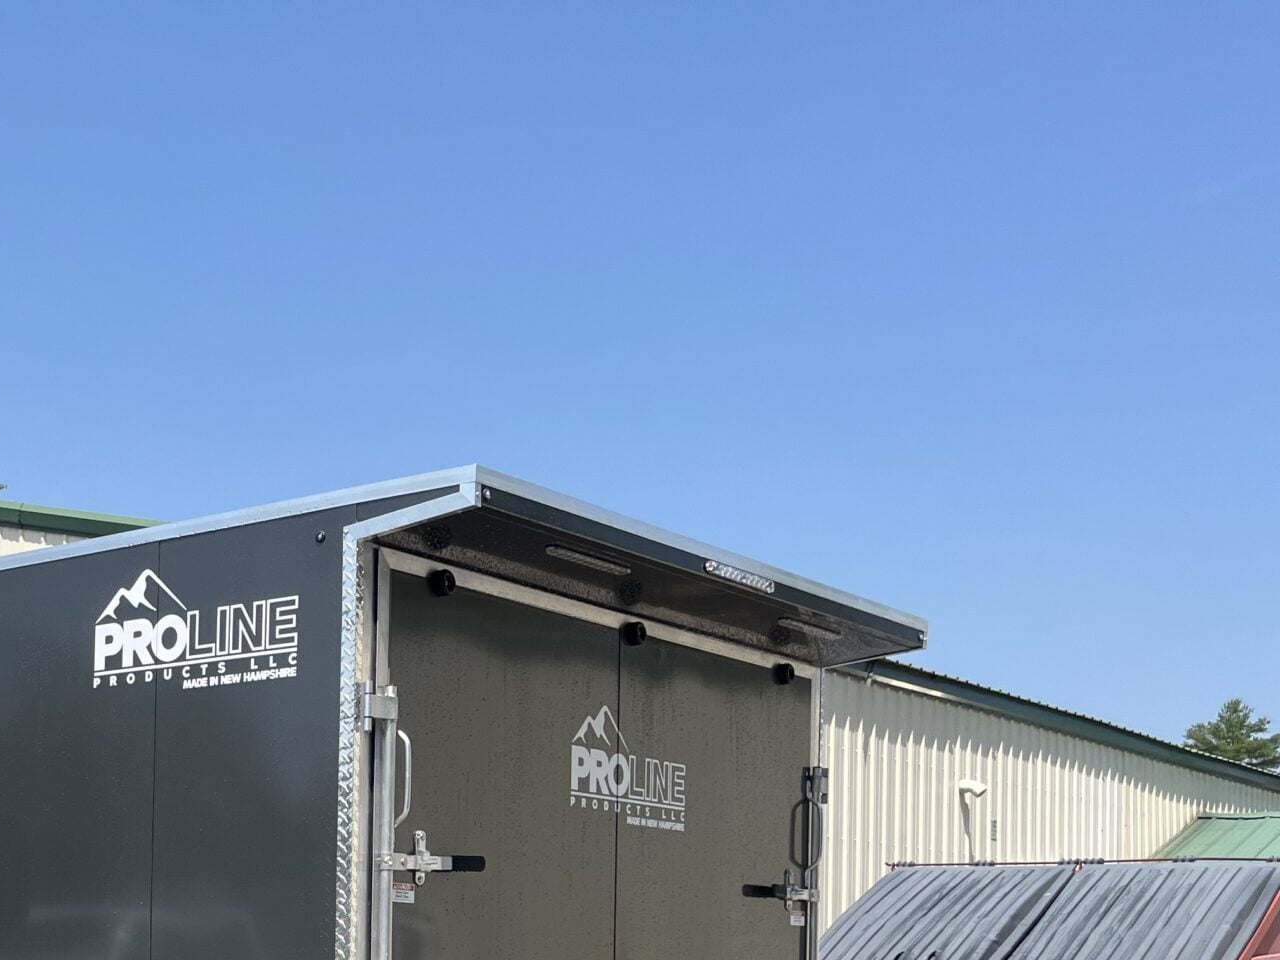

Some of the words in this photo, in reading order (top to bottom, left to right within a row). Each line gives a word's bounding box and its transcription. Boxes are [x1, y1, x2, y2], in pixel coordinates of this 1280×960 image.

[94, 595, 299, 672] PROLINE
[93, 662, 226, 688] PRODUCTS
[250, 652, 298, 670] LLC
[182, 677, 209, 690] MADE
[209, 676, 219, 687] IN
[220, 673, 241, 685] NEW
[243, 667, 298, 683] HAMPSHIRE
[570, 744, 686, 807] PROLINE
[570, 796, 650, 817] PRODUCTS
[662, 808, 685, 822] LLC
